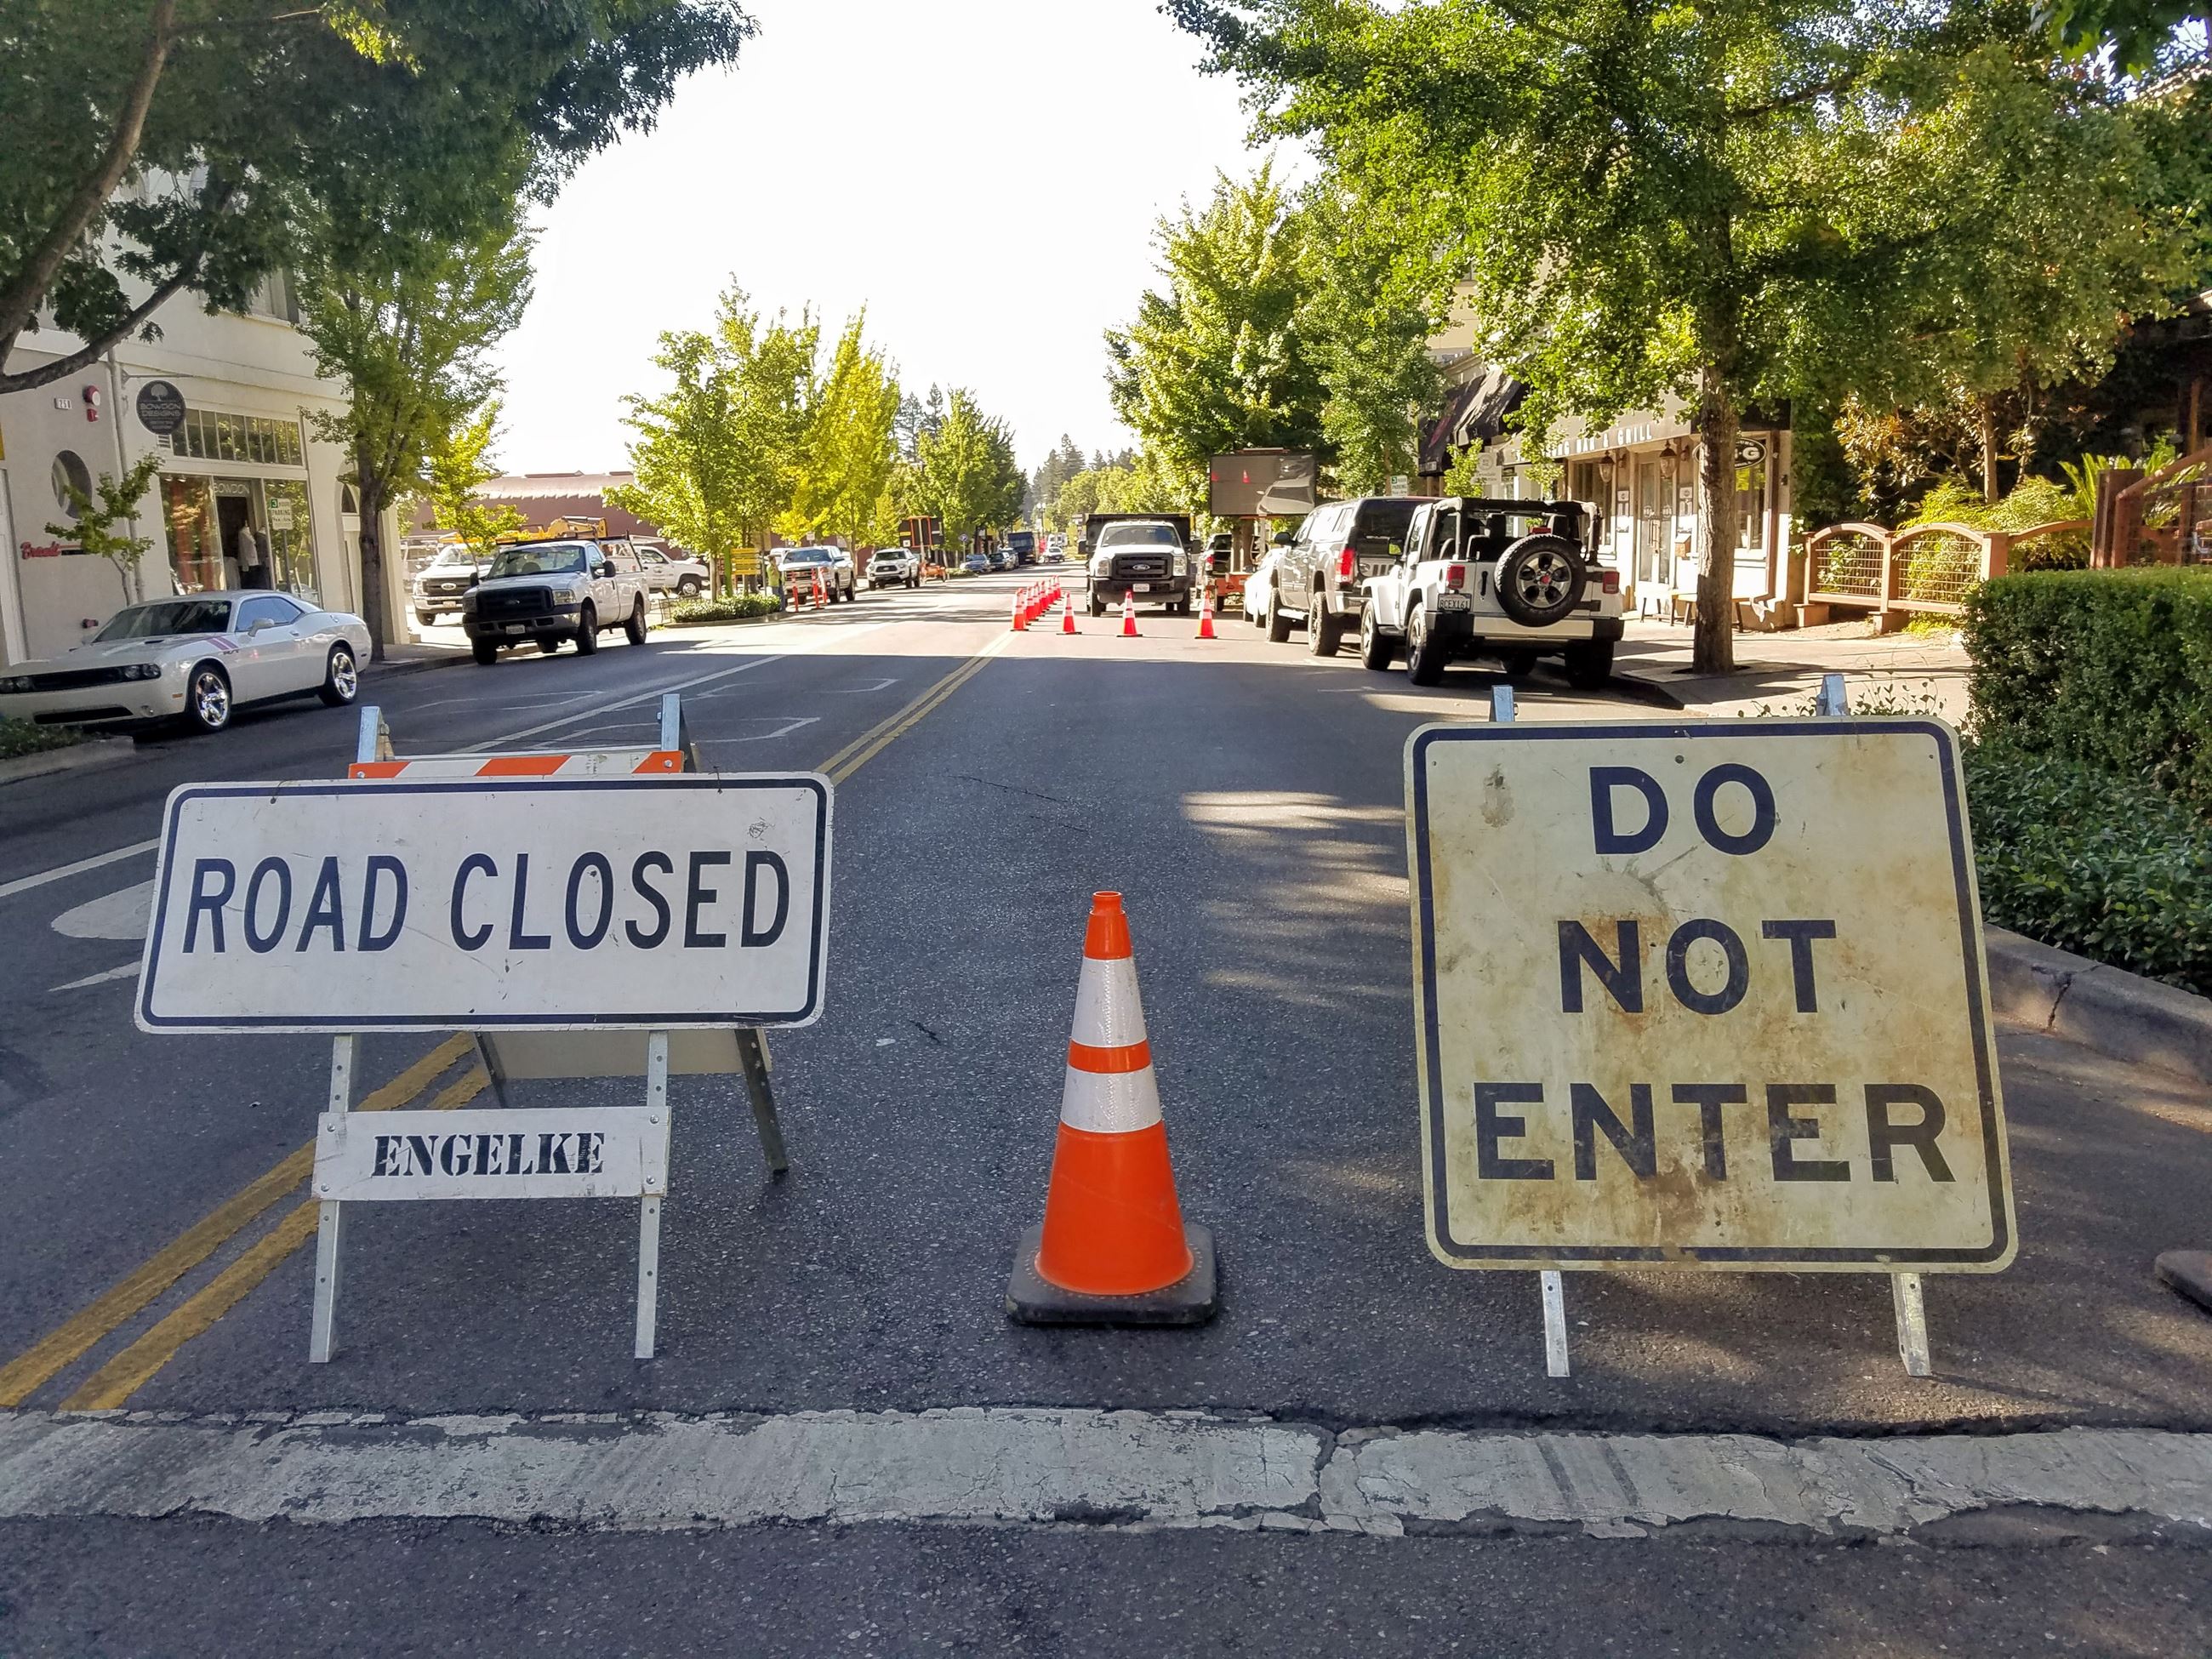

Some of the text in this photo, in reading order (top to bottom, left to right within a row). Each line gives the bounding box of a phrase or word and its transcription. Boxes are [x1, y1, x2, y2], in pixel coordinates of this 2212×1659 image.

[1603, 432, 1609, 448] &
[1617, 424, 1652, 446] GRILL
[272, 499, 277, 508] 3
[1589, 763, 1776, 856] DO
[182, 851, 790, 954] ROAD CLOSED
[1557, 919, 1837, 1015] NOT
[372, 1132, 606, 1177] ENGELKE
[1474, 1082, 1957, 1183] ENTER
